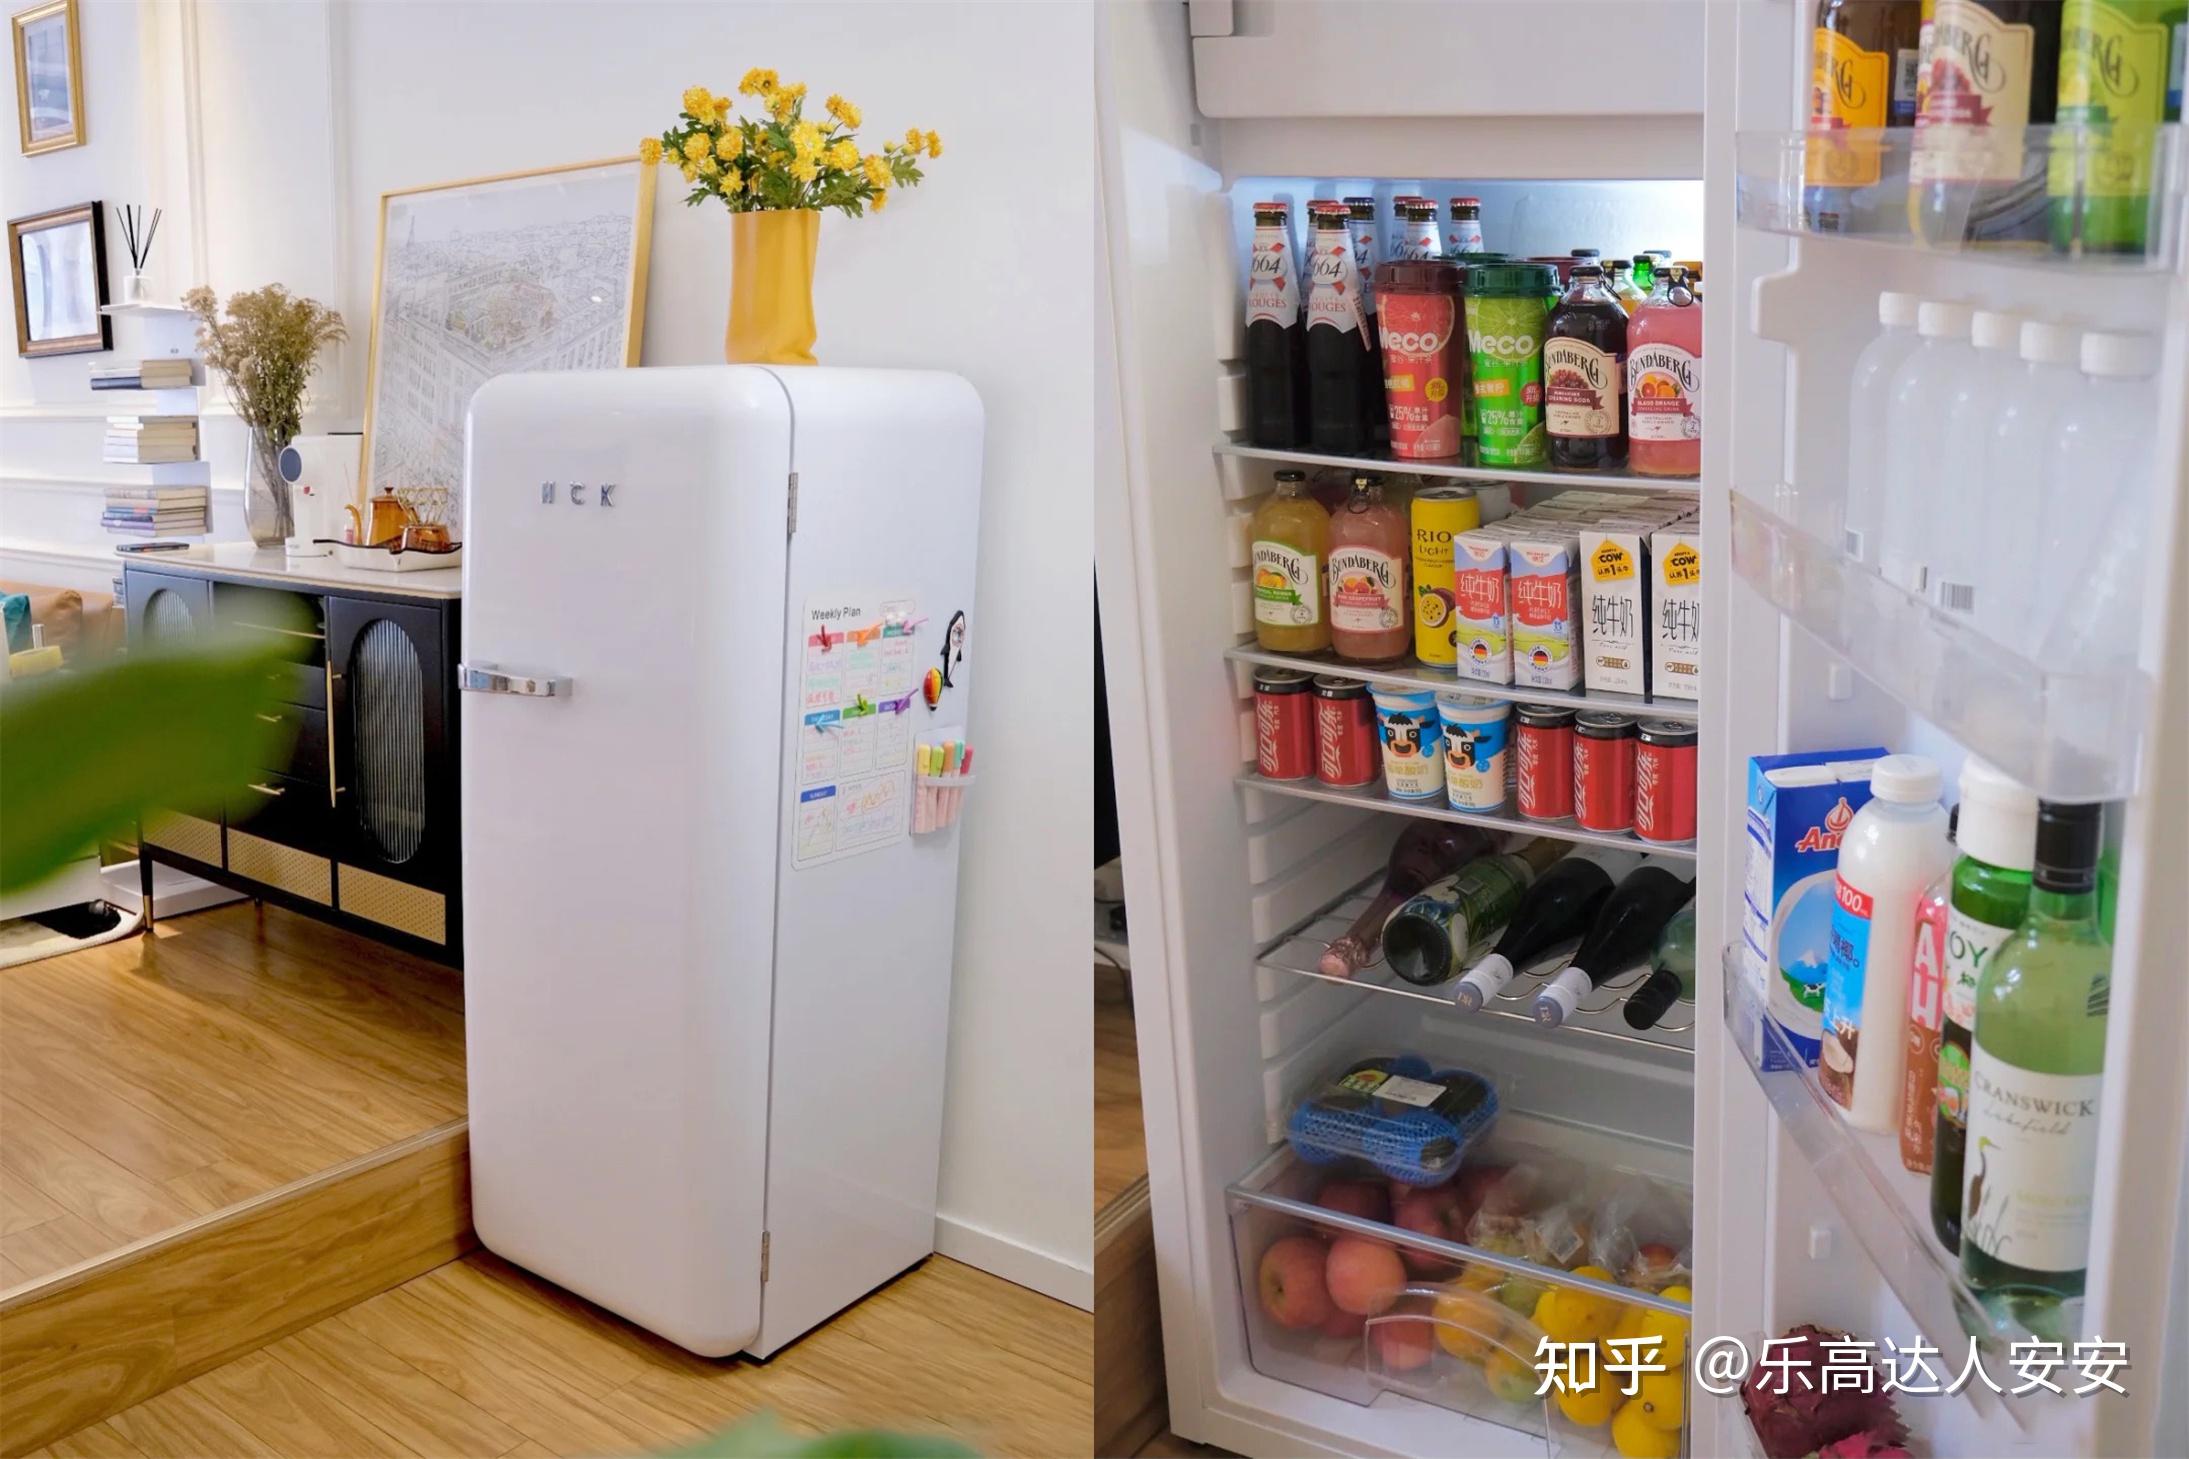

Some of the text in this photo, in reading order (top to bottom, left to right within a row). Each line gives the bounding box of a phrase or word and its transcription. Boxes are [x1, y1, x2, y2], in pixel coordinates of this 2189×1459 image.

[1378, 325, 1439, 352] Meco
[1468, 329, 1534, 355] Meco
[1417, 528, 1452, 543] RIO
[1419, 545, 1449, 556] LIGHT
[1599, 552, 1623, 563] COW
[1671, 556, 1697, 567] COW
[1460, 573, 1500, 605] 纯牛奶
[1518, 579, 1562, 609] 纯牛奶
[811, 606, 862, 621] Weekly Plan
[1592, 594, 1634, 639] 纯牛奶
[1976, 1071, 2097, 1117] CRANSWICK
